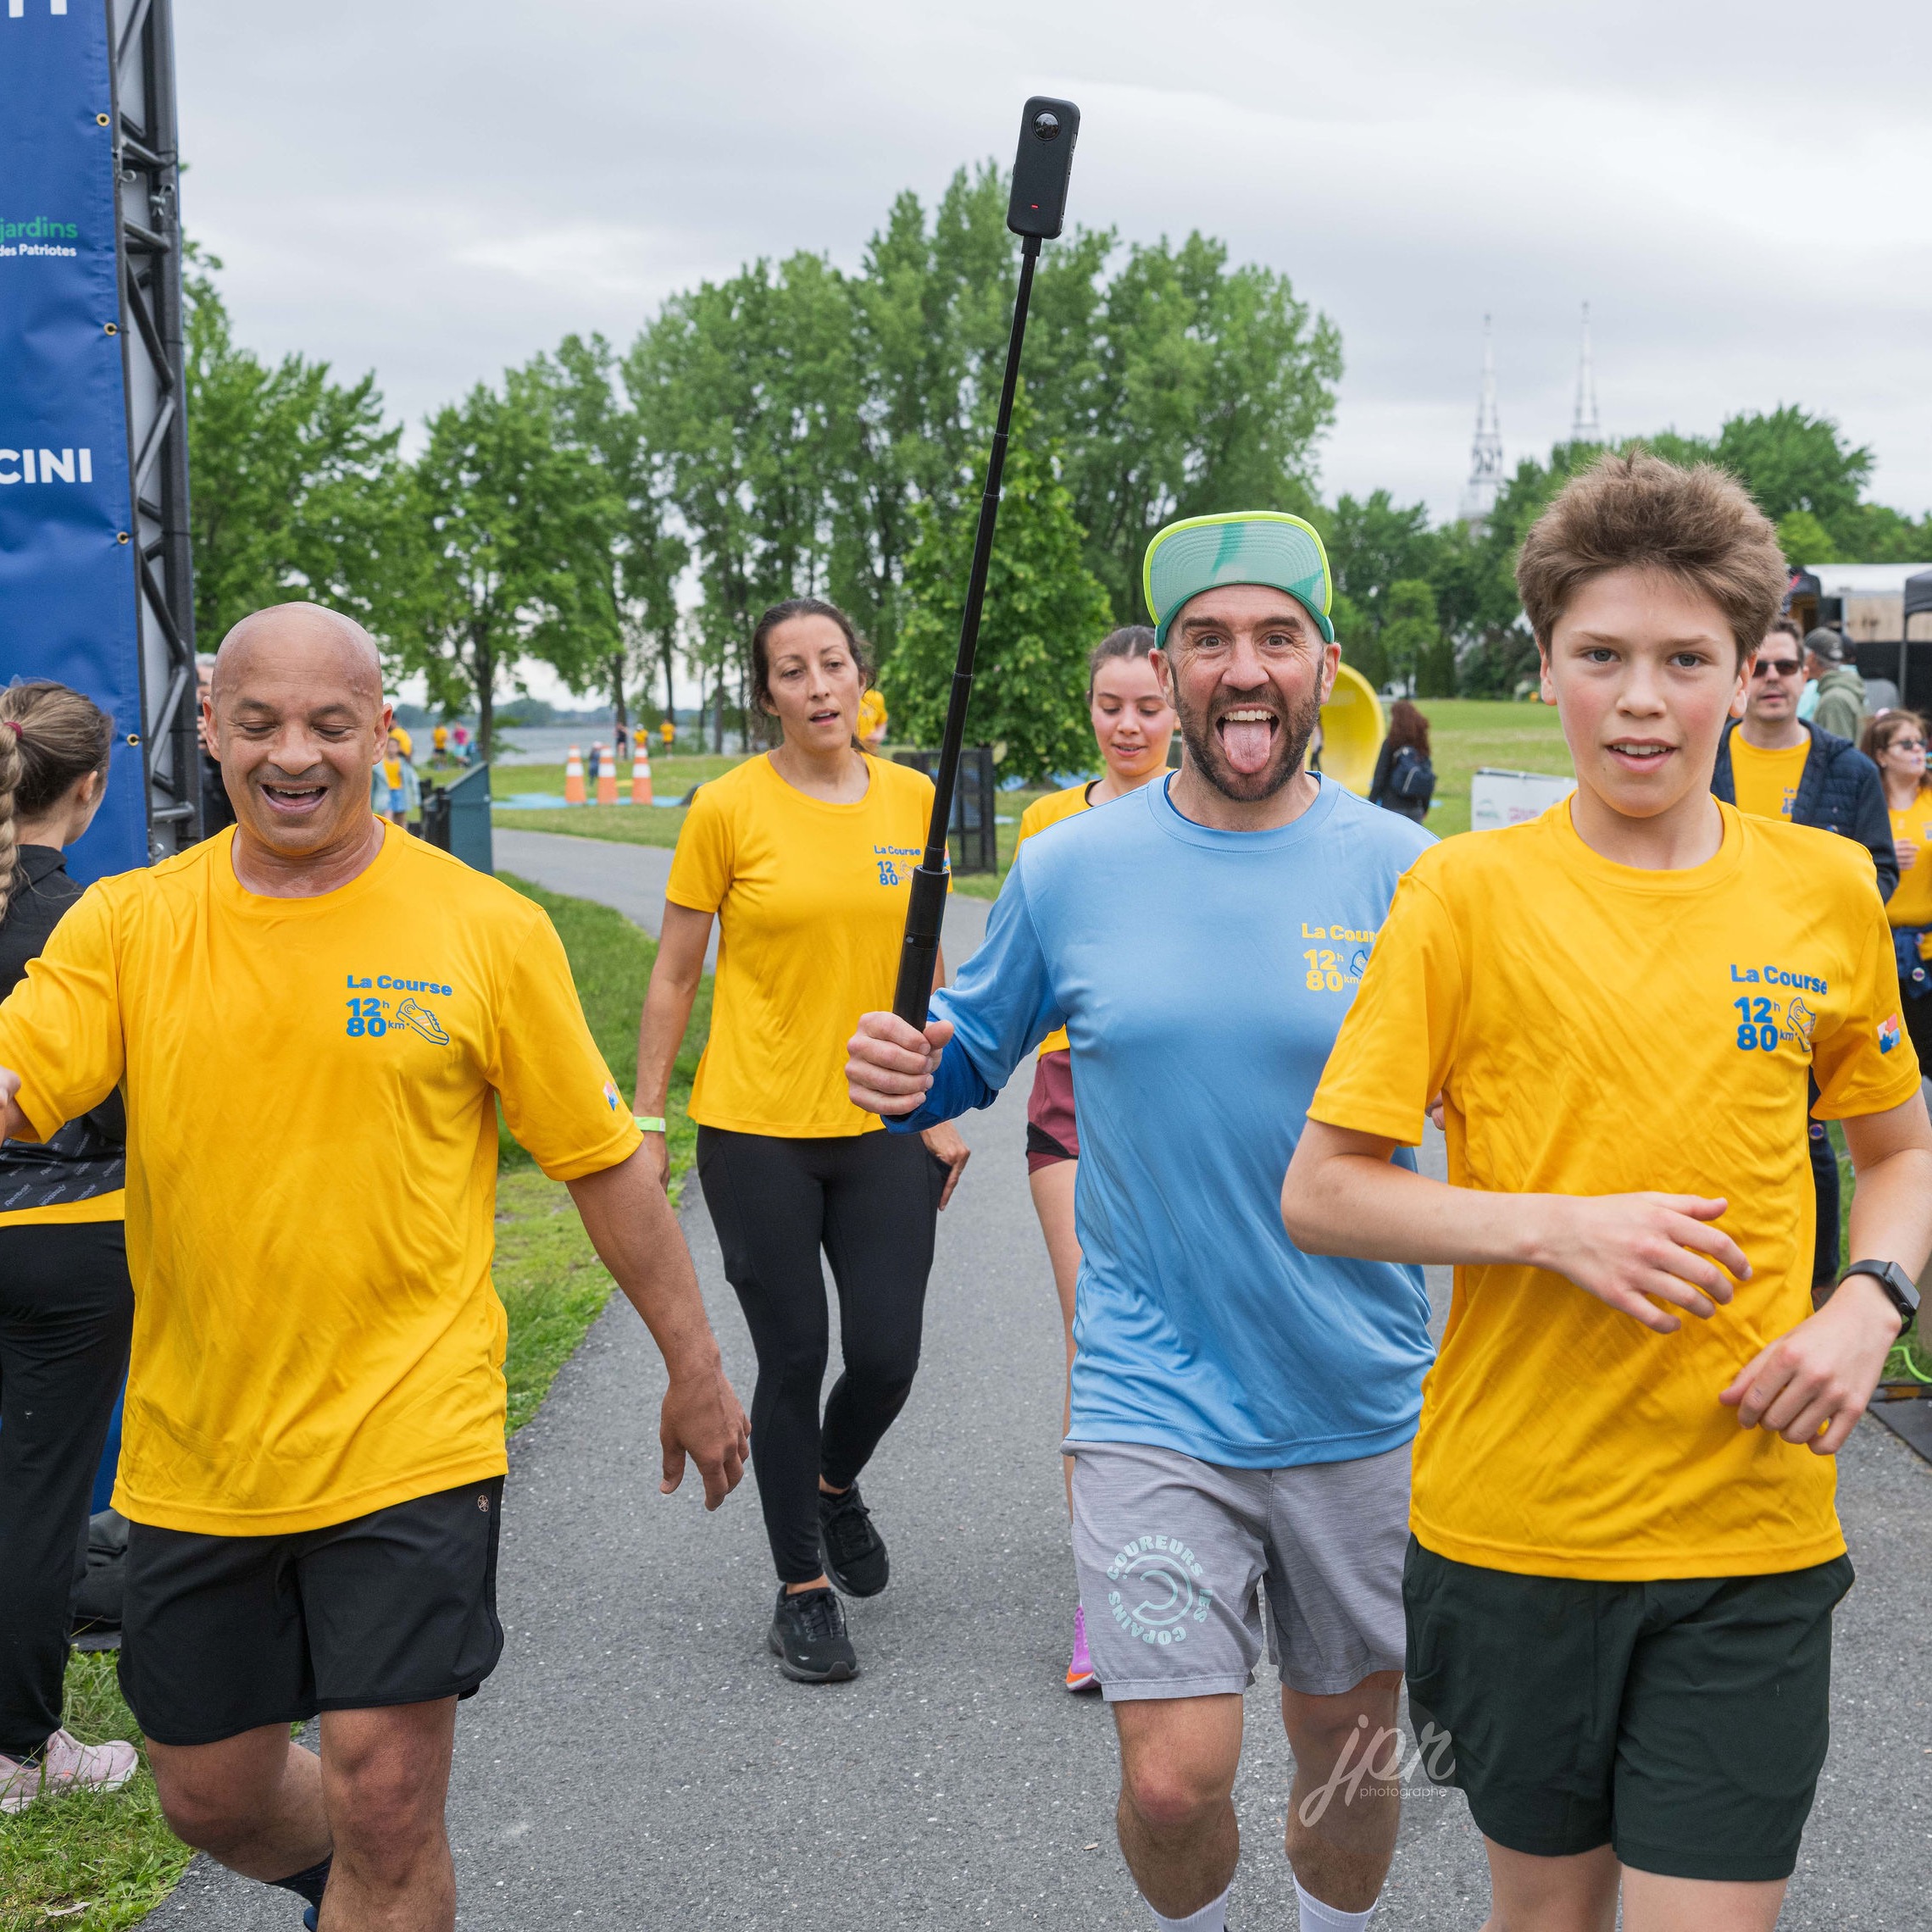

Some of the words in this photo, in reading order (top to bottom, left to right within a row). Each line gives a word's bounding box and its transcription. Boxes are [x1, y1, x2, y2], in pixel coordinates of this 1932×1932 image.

[19, 243, 77, 257] Patriotes
[874, 844, 886, 854] La
[888, 846, 921, 856] Course
[1302, 922, 1326, 939] La
[1330, 924, 1379, 943] Cour
[347, 974, 373, 989] La
[376, 974, 453, 997] Course
[1729, 963, 1760, 983] La
[1763, 965, 1828, 996] Course
[1107, 1535, 1203, 1580] COUREURS
[1108, 1591, 1186, 1646] COPAINS
